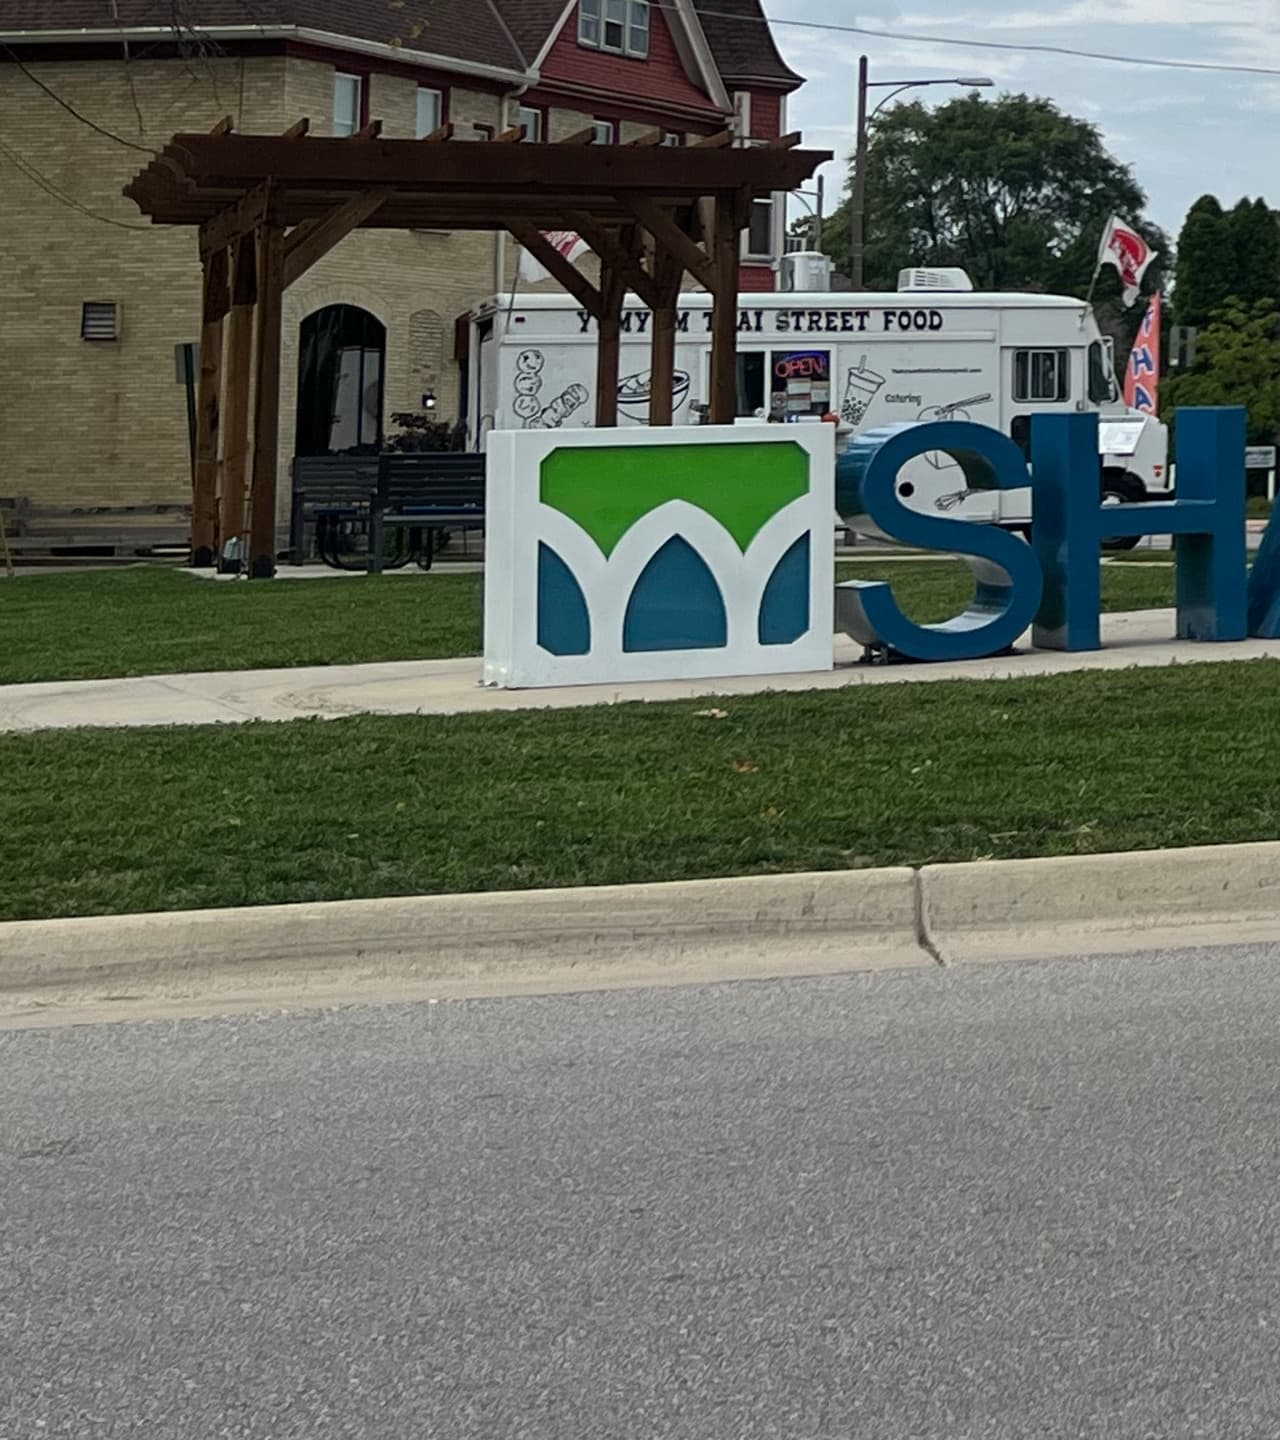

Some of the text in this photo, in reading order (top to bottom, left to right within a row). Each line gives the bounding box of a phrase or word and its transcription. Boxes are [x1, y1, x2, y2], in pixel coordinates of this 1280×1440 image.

[577, 310, 943, 333] YMYM TAI STREET FOOD
[775, 357, 824, 378] OPEN
